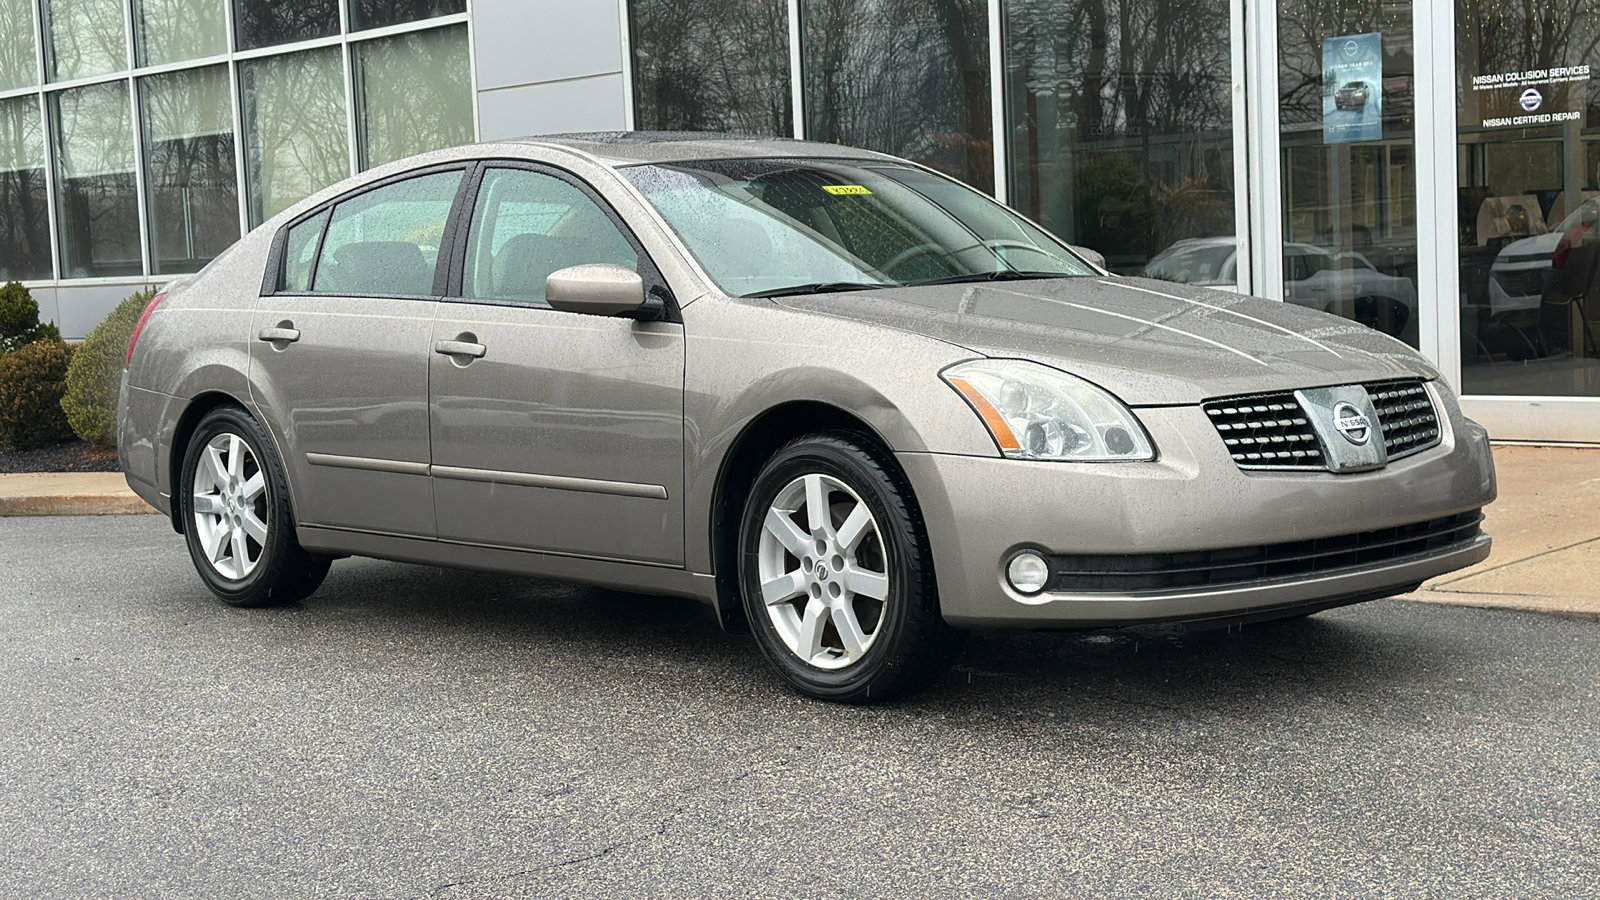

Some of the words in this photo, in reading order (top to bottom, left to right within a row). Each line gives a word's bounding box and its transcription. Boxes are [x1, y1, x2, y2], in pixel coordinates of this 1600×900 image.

[1473, 74, 1504, 85] NISSAN
[1505, 69, 1548, 82] COLLISION
[1549, 65, 1590, 77] SERVICES
[1483, 117, 1512, 128] NISSAN
[1513, 113, 1551, 125] CERTIFIED
[1552, 111, 1581, 122] REPAIR
[1340, 417, 1368, 428] NISSAN
